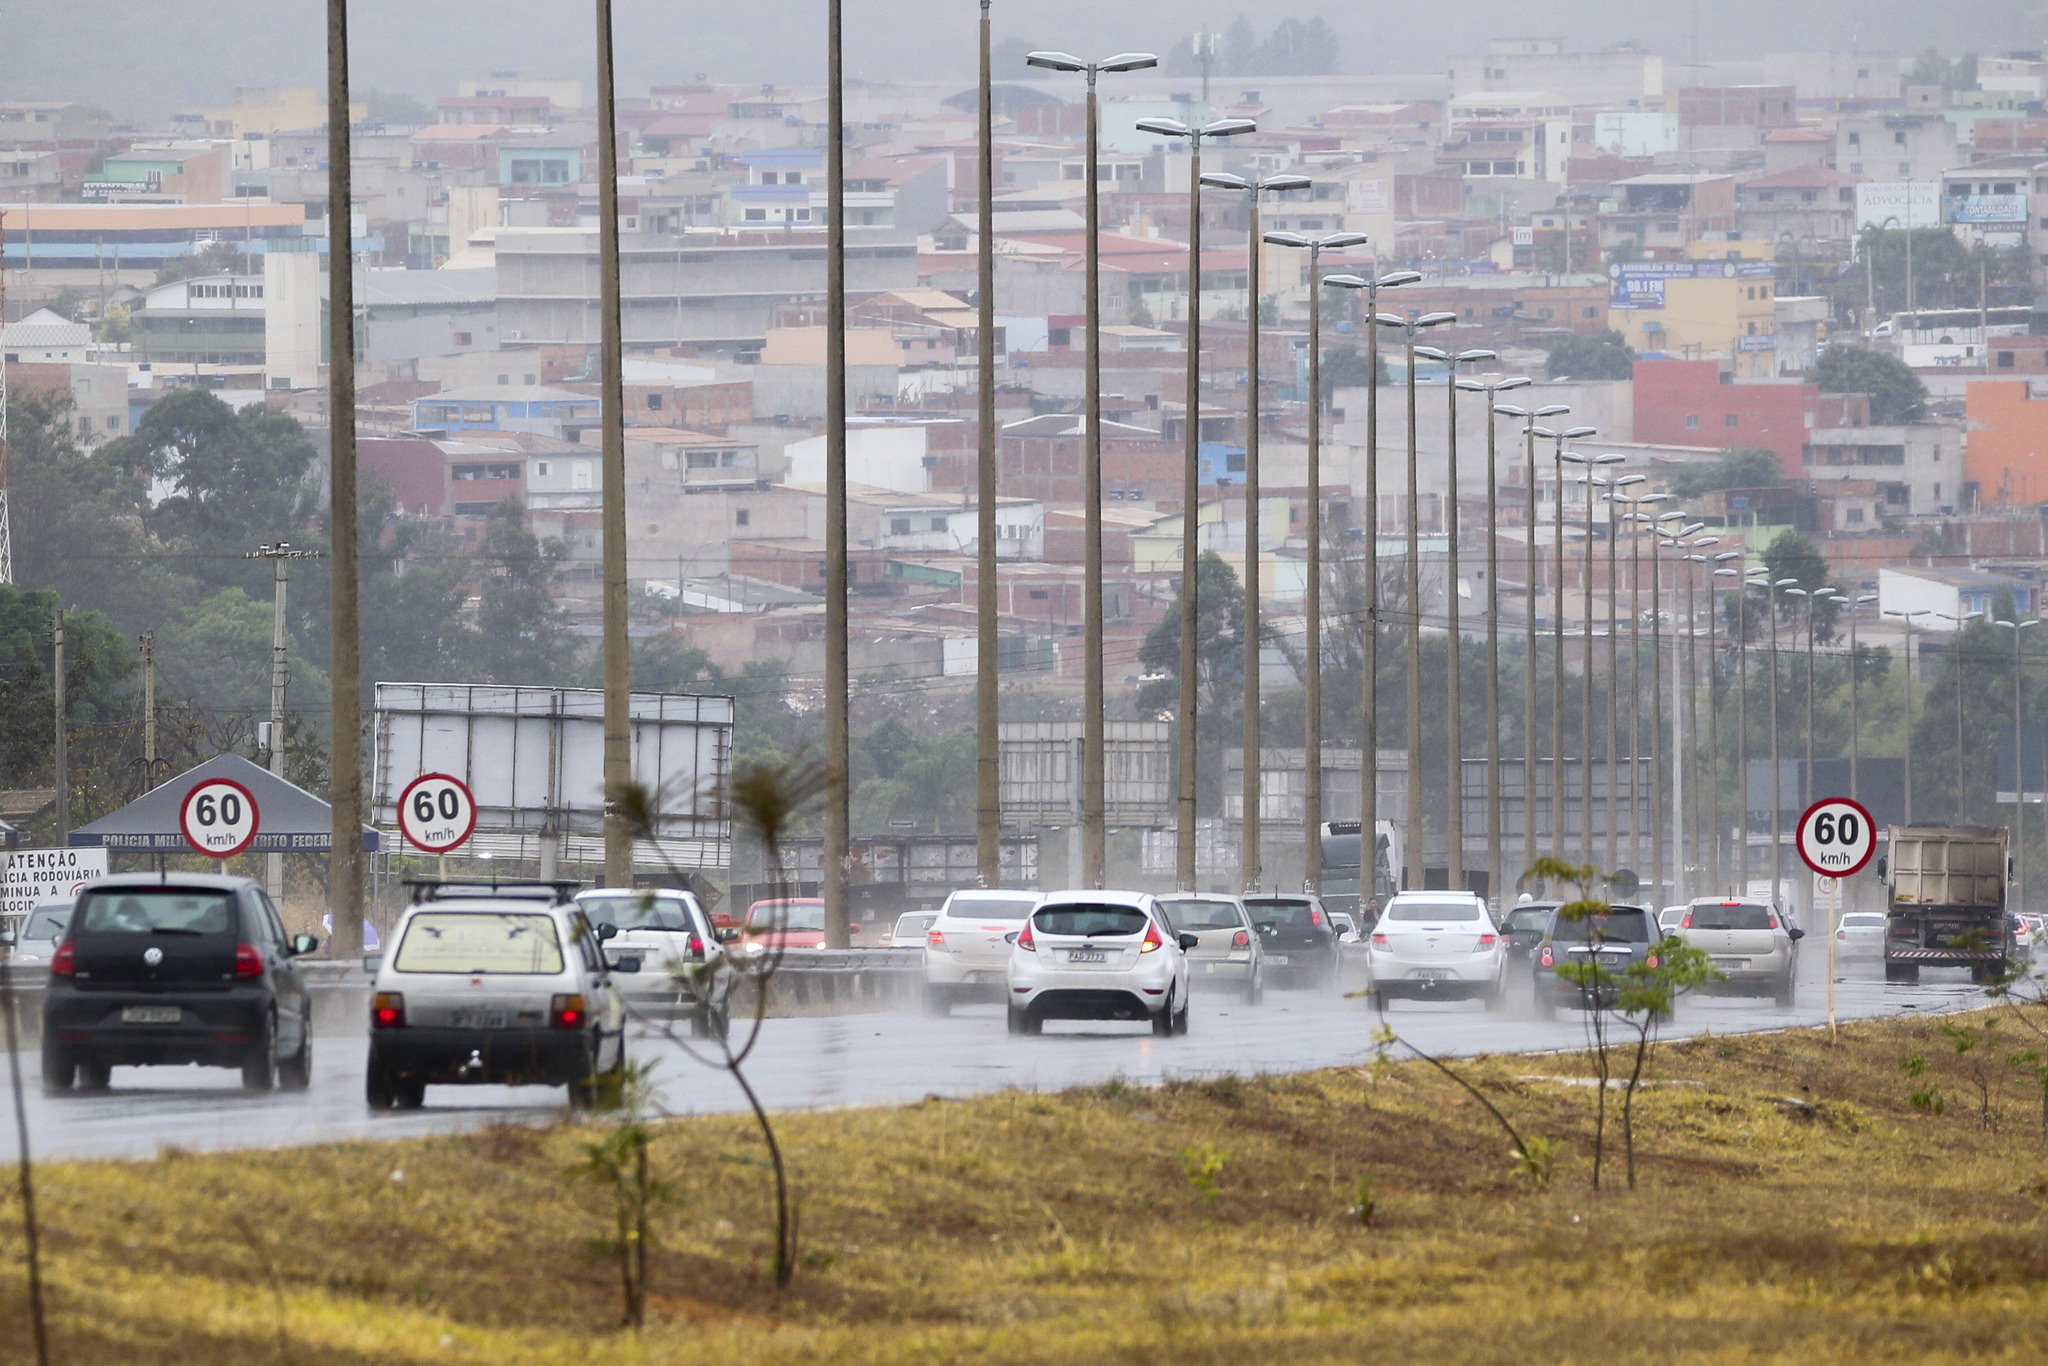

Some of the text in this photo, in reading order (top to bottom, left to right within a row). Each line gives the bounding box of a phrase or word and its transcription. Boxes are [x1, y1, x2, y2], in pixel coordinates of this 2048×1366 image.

[1864, 195, 1933, 205] ADVOCACIA
[197, 794, 241, 826] 60
[414, 788, 459, 822] 60
[425, 827, 455, 841] km/h
[1815, 812, 1859, 845] 60
[102, 833, 150, 847] POLÍCIA
[206, 833, 236, 845] km/h
[8, 851, 77, 870] ATENÇÃO
[1821, 851, 1851, 865] km/h
[33, 868, 101, 882] RODOVIÁRIA
[0, 885, 58, 898] MINUA A
